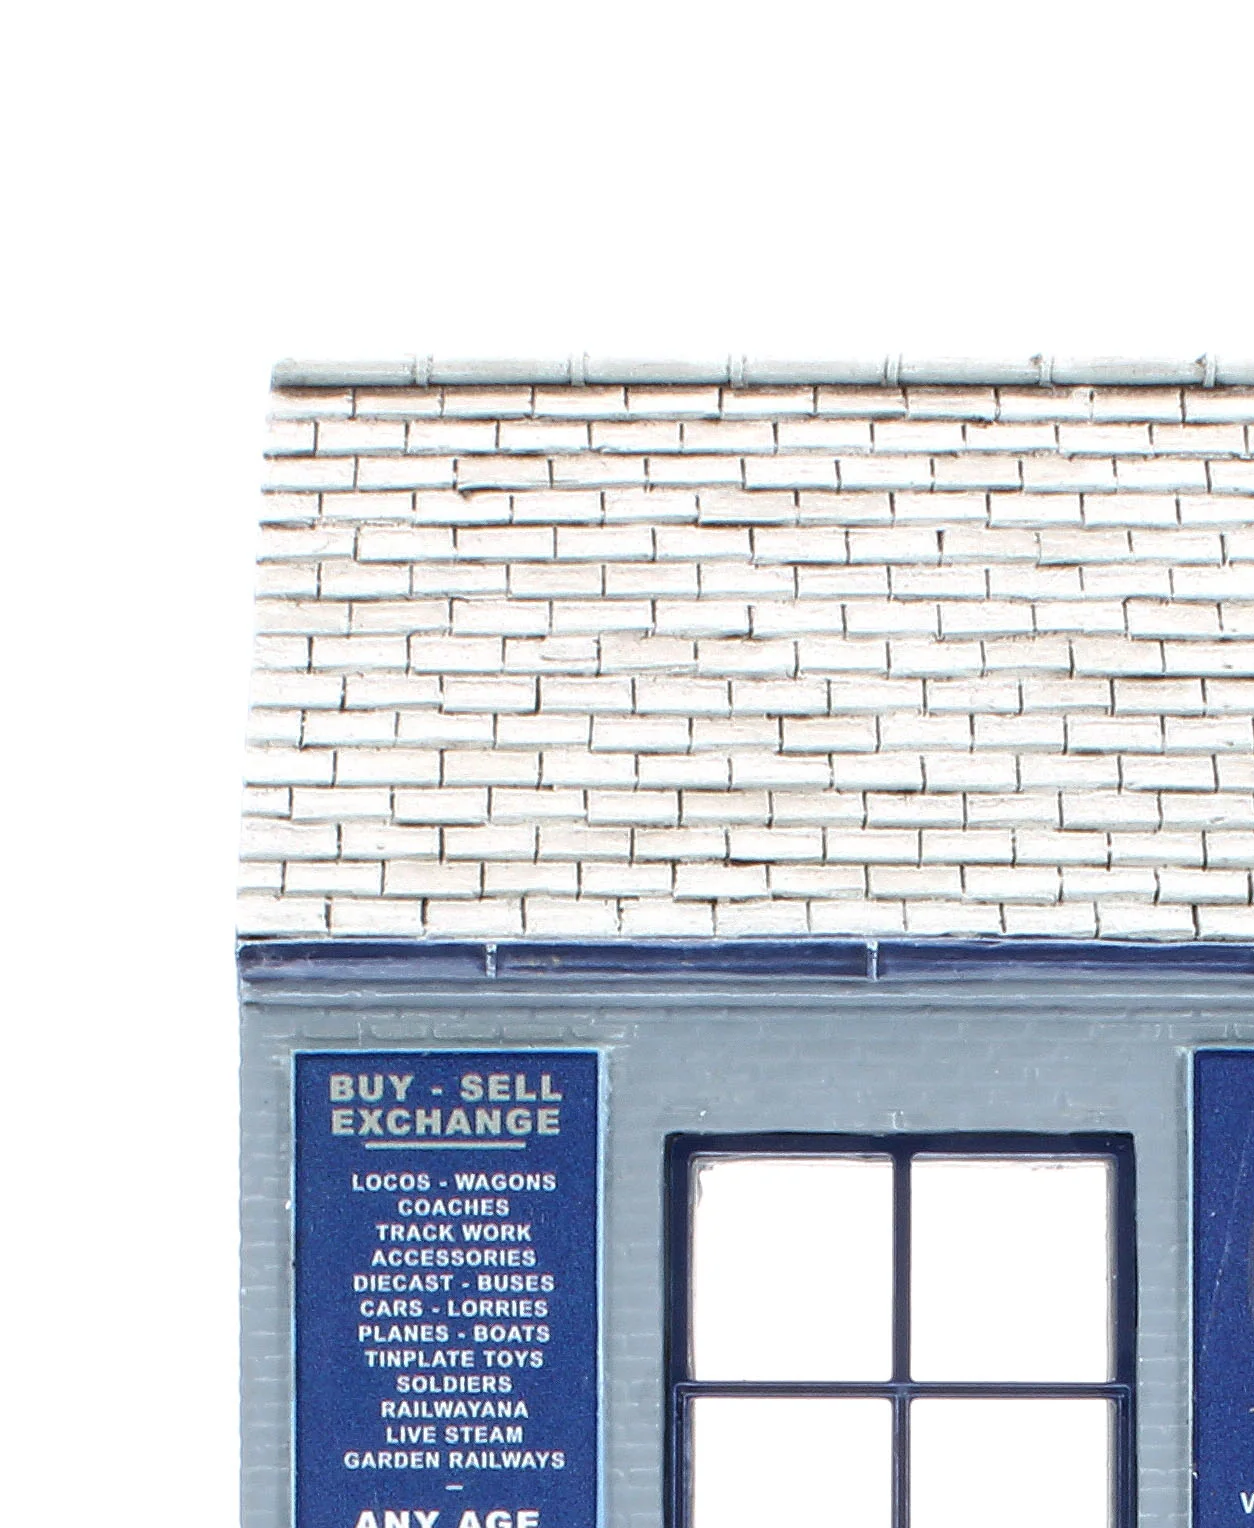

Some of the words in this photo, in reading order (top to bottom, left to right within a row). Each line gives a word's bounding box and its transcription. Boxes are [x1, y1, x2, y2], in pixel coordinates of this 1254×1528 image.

[329, 1073, 414, 1101] BUY
[460, 1072, 563, 1101] SELL
[331, 1107, 561, 1135] EXCHANGE
[351, 1171, 431, 1192] LOCOS
[454, 1172, 556, 1191] WAGONS
[397, 1197, 510, 1217] COACHES
[375, 1221, 455, 1242] TRACK
[461, 1222, 532, 1242] WORK
[371, 1246, 537, 1267] ACCESSORIES
[353, 1271, 454, 1293] DIECAST
[477, 1273, 555, 1292] BUSES
[359, 1298, 423, 1318] CARS
[447, 1297, 549, 1318] LORRIES
[358, 1323, 449, 1343] PLANES
[473, 1323, 551, 1343] BOATS
[364, 1348, 475, 1368] TINPLATE
[482, 1349, 544, 1369] TOYS
[396, 1373, 513, 1394] SOLDIERS
[380, 1399, 529, 1419] RAILWAYANA
[386, 1424, 437, 1444] LIVE
[444, 1424, 523, 1444] STEAM
[343, 1450, 440, 1469] GARDEN
[448, 1450, 566, 1469] RAILWAYS
